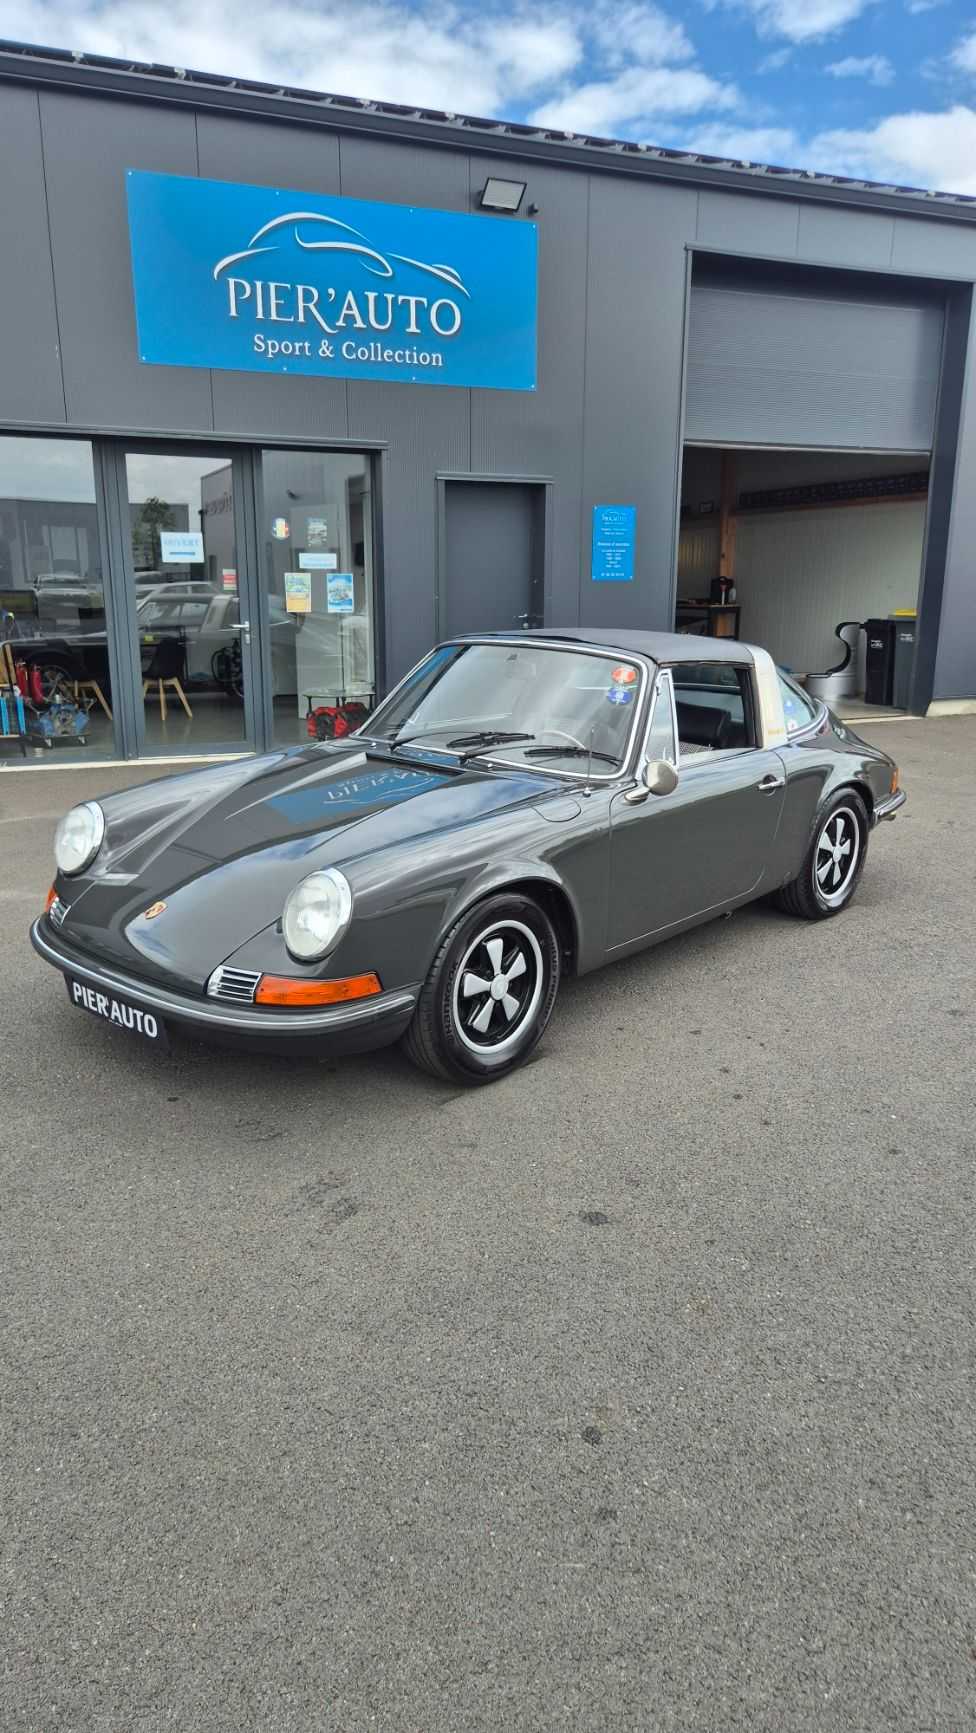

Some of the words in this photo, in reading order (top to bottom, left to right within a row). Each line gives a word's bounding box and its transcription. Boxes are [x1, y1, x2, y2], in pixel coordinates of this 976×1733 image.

[227, 277, 462, 337] PIER'AUTO
[253, 334, 311, 358] Sport
[319, 339, 335, 358] &
[342, 341, 443, 367] Collection
